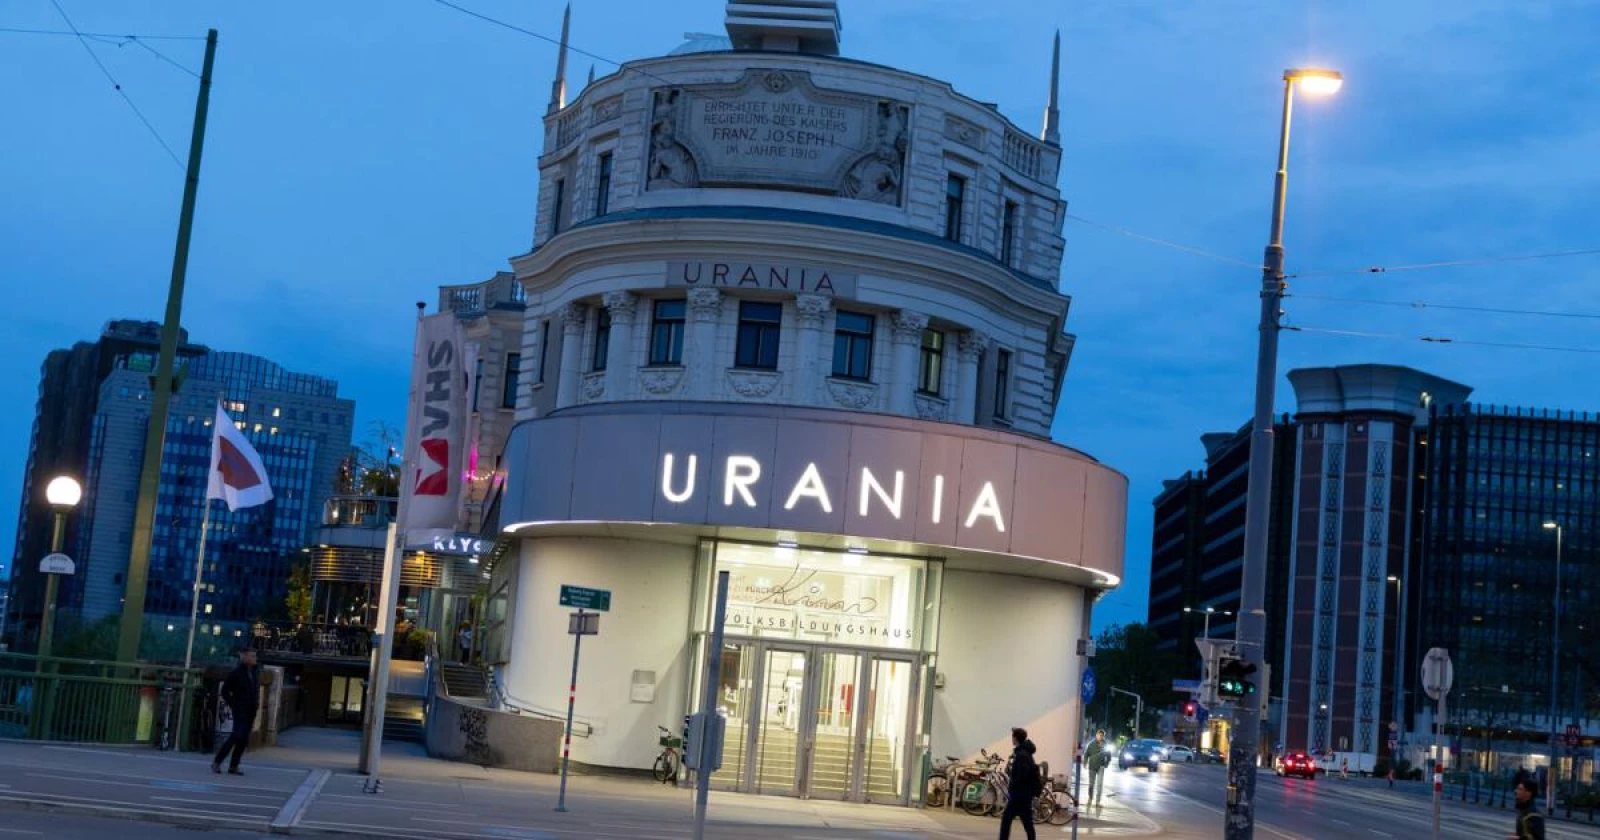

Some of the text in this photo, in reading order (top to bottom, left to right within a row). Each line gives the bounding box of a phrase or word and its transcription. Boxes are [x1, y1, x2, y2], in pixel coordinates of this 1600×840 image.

[704, 100, 845, 119] ERRICHTET UNTER DER
[704, 112, 848, 133] REGIERUNG DES KAISERS
[712, 127, 758, 141] FRANZ
[762, 129, 825, 146] JOSEPH
[725, 144, 818, 159] IM JAHRE 1910
[683, 263, 836, 295] URANIA
[421, 339, 454, 438] VHS
[661, 453, 1006, 533] URANIA
